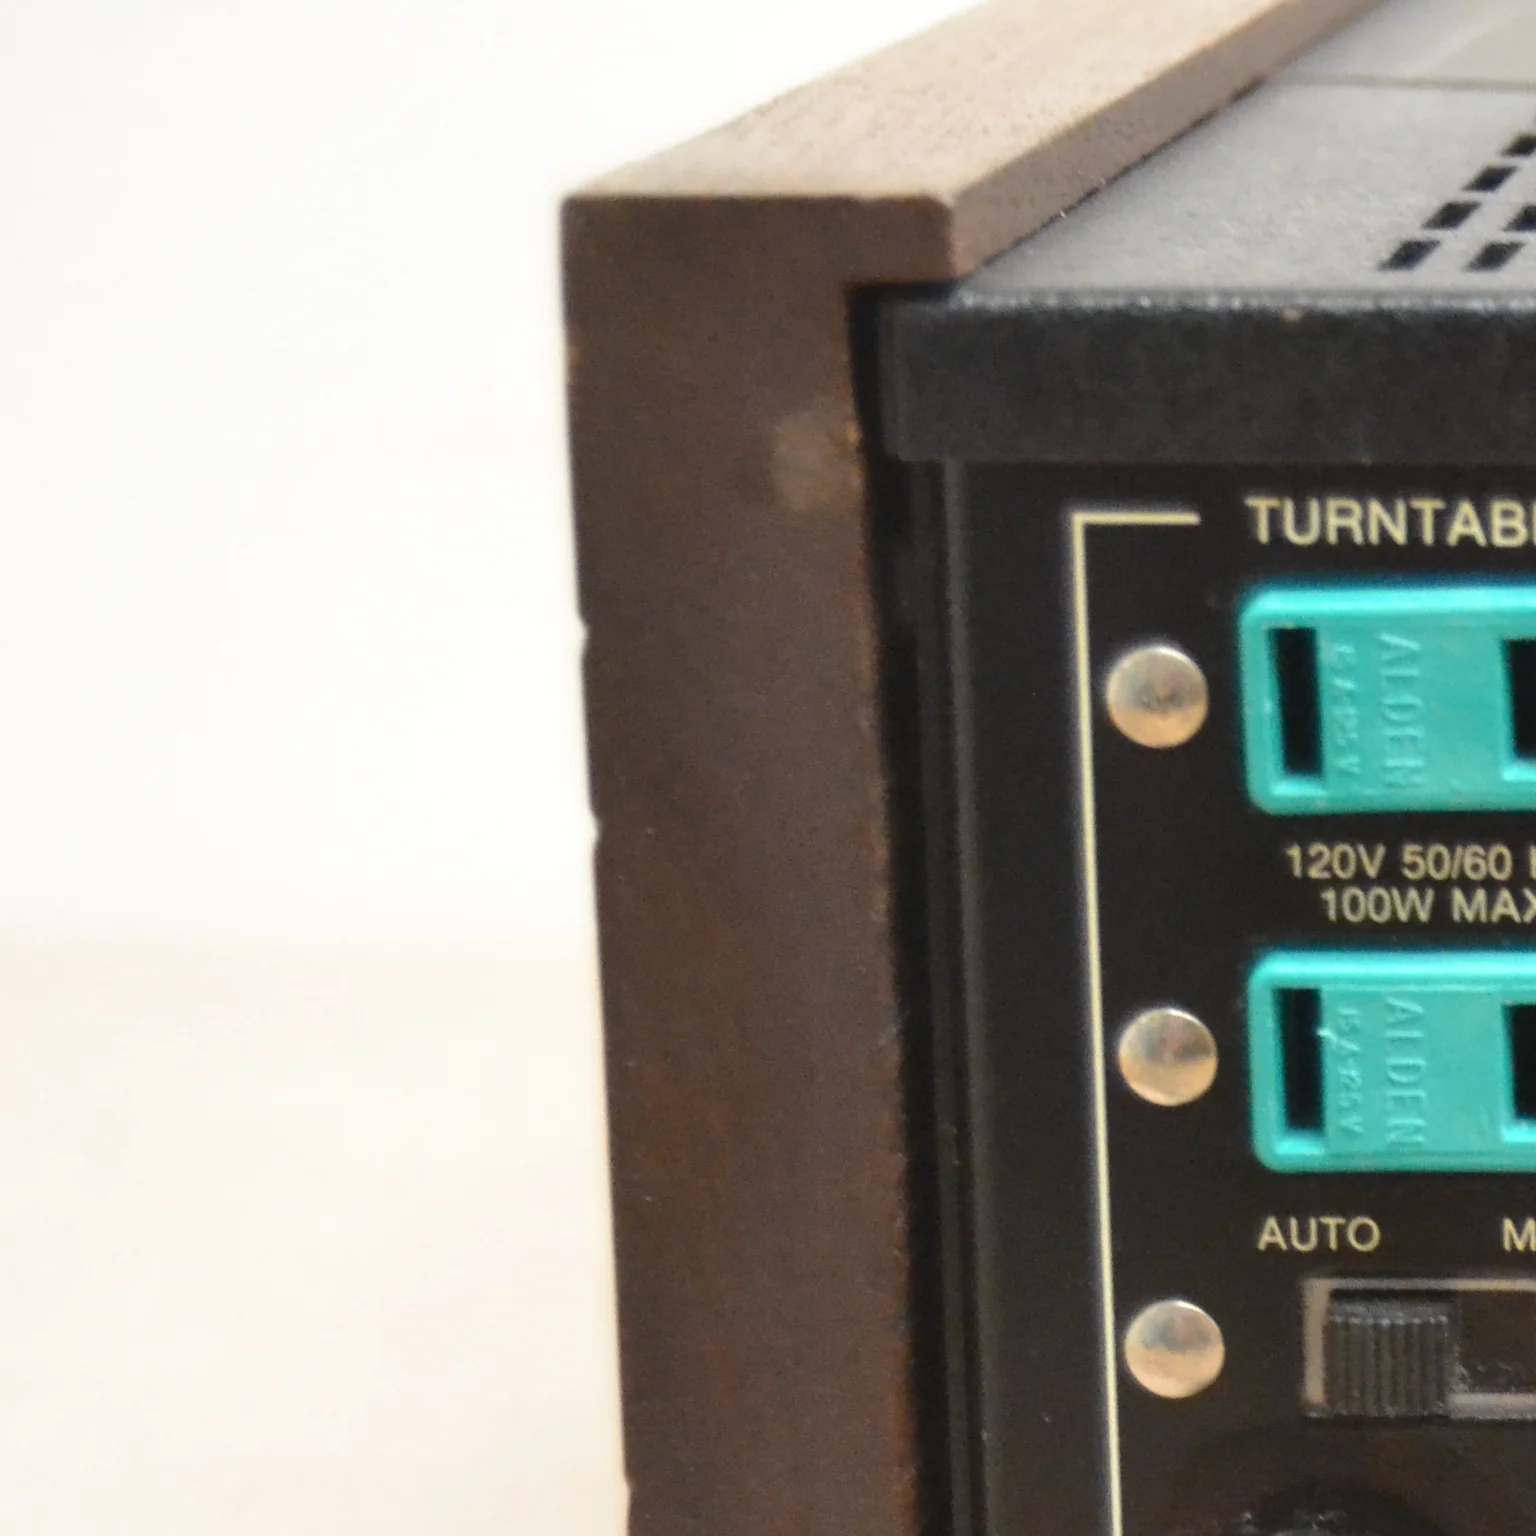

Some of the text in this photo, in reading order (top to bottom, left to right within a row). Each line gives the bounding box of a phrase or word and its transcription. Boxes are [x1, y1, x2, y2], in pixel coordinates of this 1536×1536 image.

[1286, 842, 1385, 879] 120V
[1402, 844, 1512, 880] 50/60
[1321, 886, 1434, 923] 100W
[1258, 1217, 1380, 1251] AUTO
